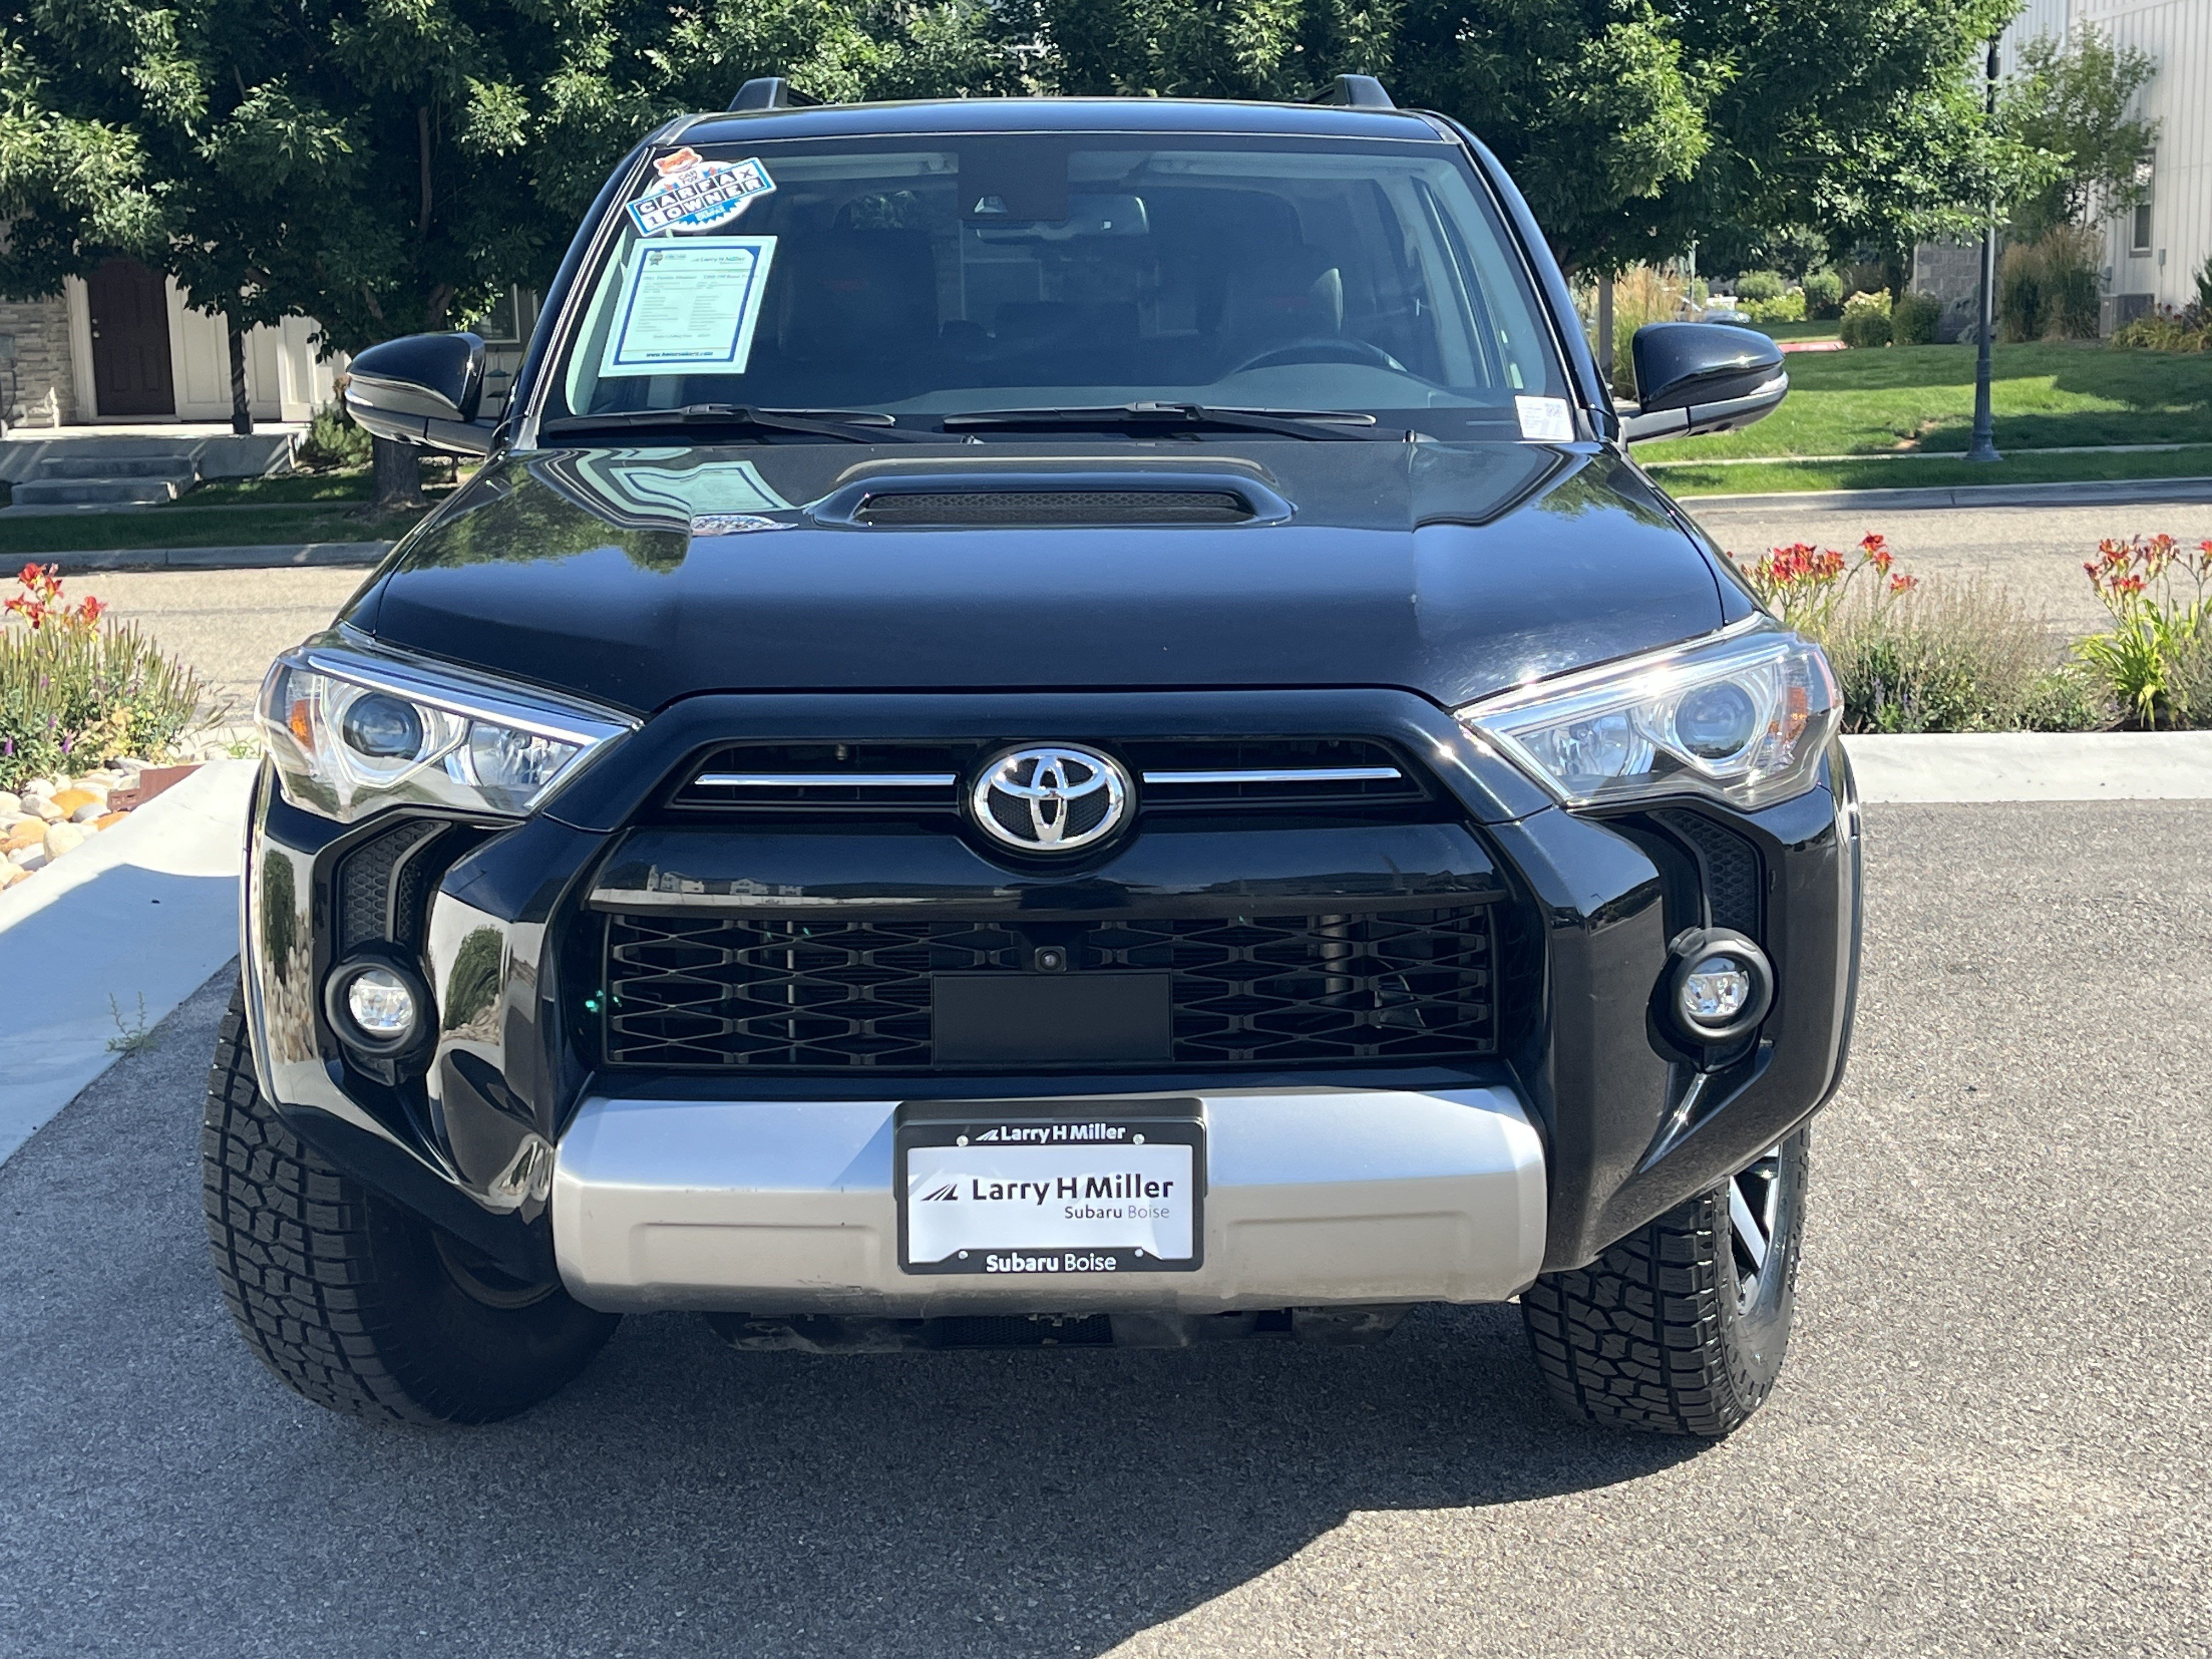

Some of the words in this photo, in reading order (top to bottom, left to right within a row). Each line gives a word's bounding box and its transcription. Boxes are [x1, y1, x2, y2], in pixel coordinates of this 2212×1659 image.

[636, 168, 754, 216] CARFAX
[648, 216, 660, 226] 1
[663, 177, 765, 220] OWNER
[1000, 1125, 1051, 1144] Larry
[1052, 1125, 1068, 1140] H
[1069, 1123, 1126, 1141] Miller
[972, 1178, 1051, 1206] Larry
[1057, 1177, 1077, 1199] H
[1085, 1173, 1175, 1199] Miller
[1064, 1205, 1122, 1219] Subaru
[1128, 1204, 1170, 1218] Boise
[986, 1253, 1059, 1273] Subaru
[1064, 1252, 1116, 1272] Boise
